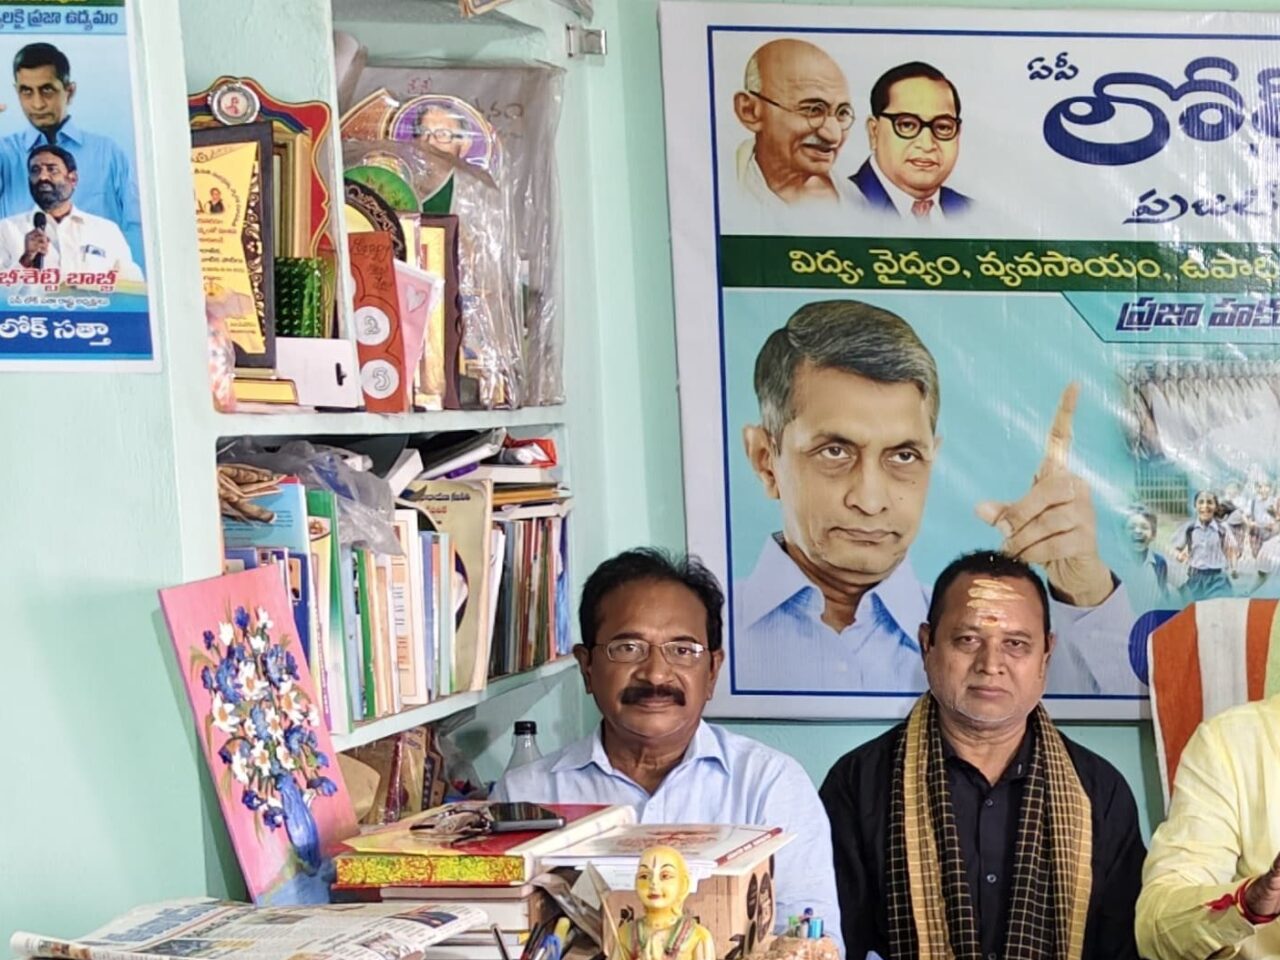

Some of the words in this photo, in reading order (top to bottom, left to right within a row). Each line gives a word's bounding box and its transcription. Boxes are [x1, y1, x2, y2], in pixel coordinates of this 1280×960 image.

[1027, 52, 1079, 81] ఏపీ
[1115, 297, 1204, 331] ప్రజా
[53, 319, 112, 346] సత్తా
